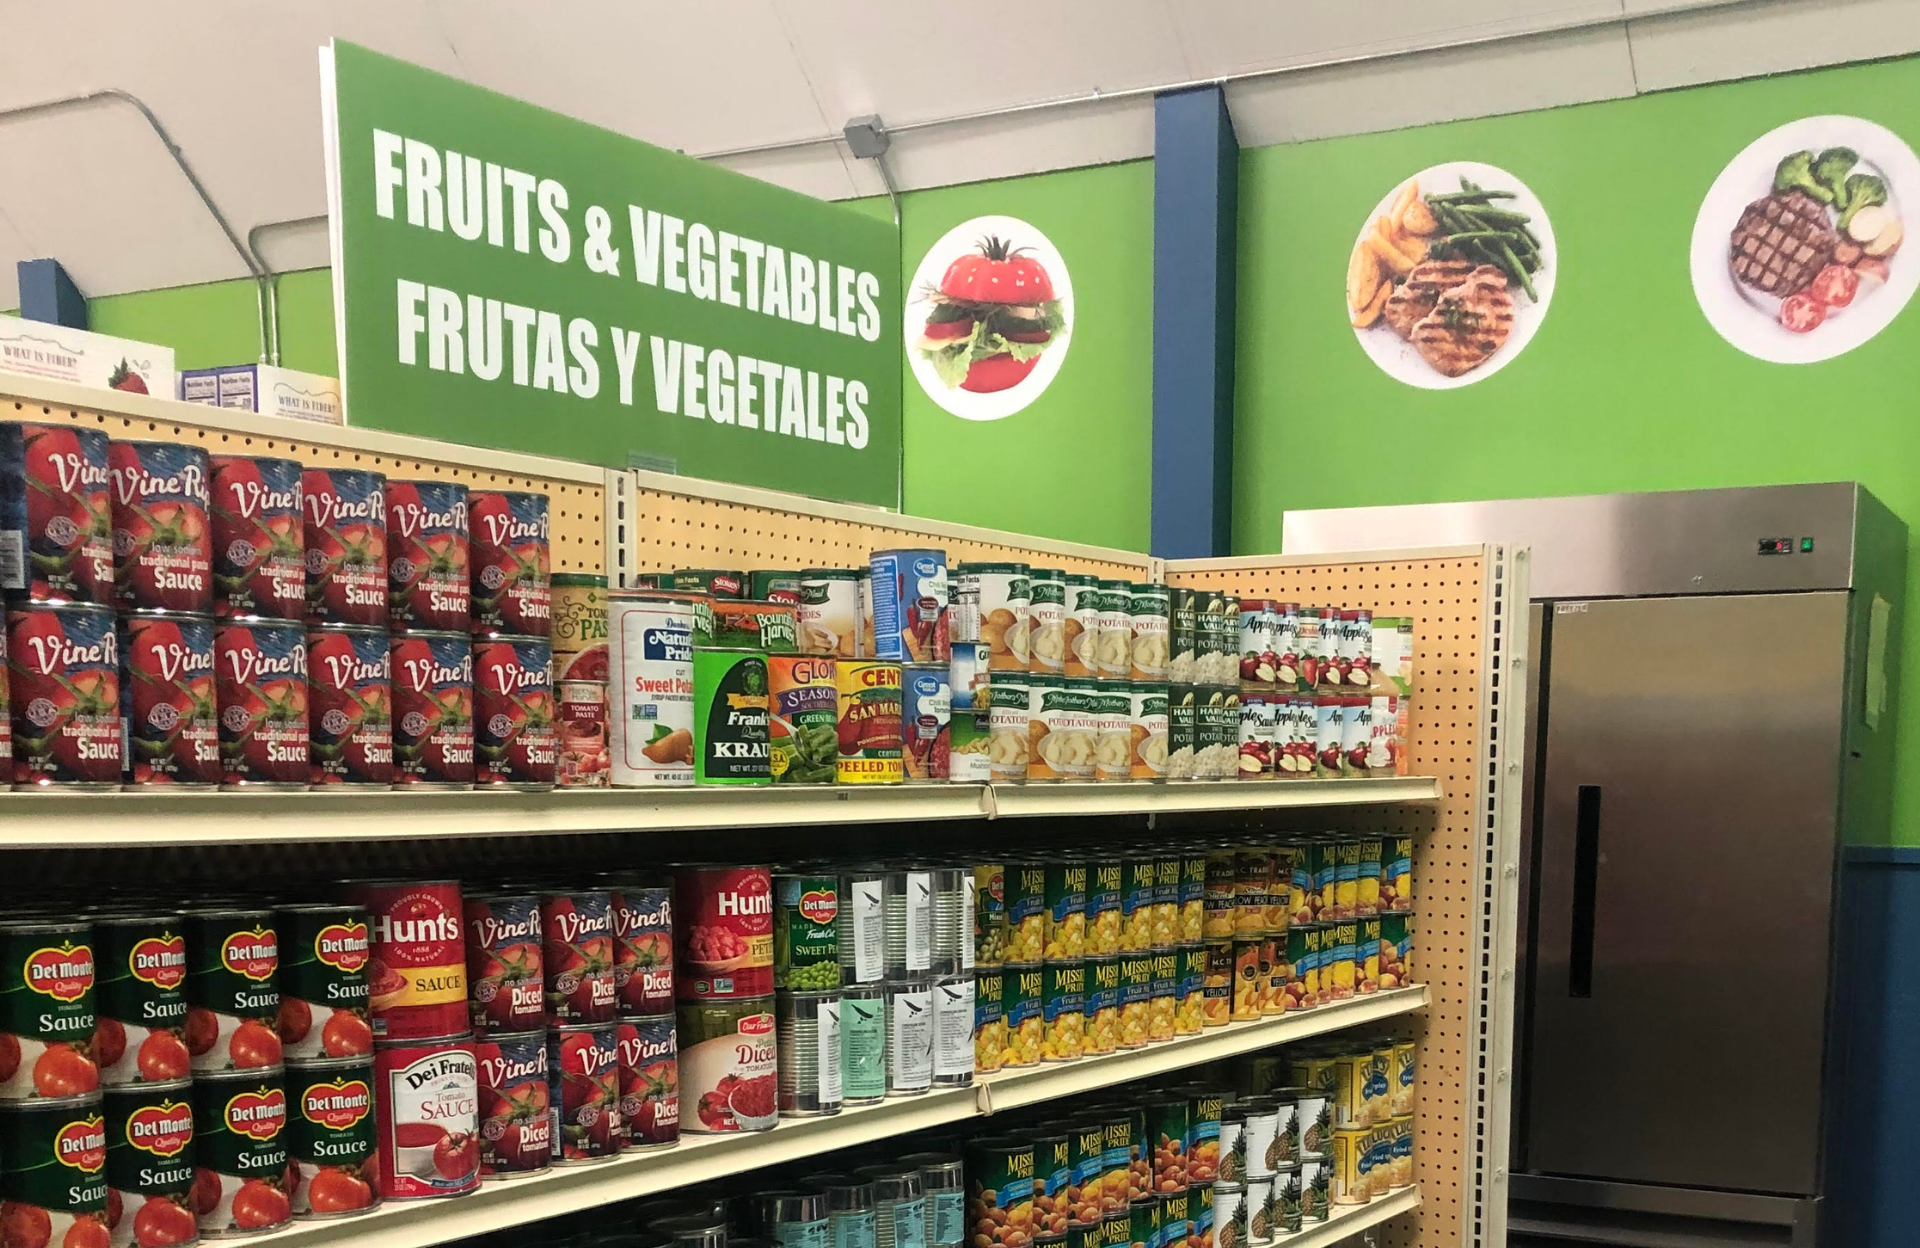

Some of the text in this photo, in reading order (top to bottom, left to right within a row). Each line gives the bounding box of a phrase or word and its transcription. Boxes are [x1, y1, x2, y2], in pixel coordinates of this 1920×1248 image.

[372, 128, 882, 343] FRUITS & VEGETABLES
[3, 344, 31, 360] WHAT
[397, 278, 869, 450] FRUTAS Y VEGETALES
[278, 394, 300, 409] WHAT
[302, 399, 310, 409] IS
[230, 481, 292, 519] Vine
[305, 491, 368, 529] Vine
[393, 501, 451, 538] Vine
[483, 512, 540, 547] Vine
[154, 569, 203, 591] Sauce
[345, 584, 384, 607] Sauce
[430, 591, 467, 613] Sauce
[28, 636, 100, 676] Vine
[151, 643, 210, 682] Vine
[225, 647, 291, 685] Vine
[324, 654, 383, 690] Vine
[404, 658, 462, 693] Vine
[491, 662, 545, 696] Vine
[635, 676, 675, 693] Sweet
[571, 704, 599, 713] TOMATO
[575, 711, 595, 719] PASTE
[849, 704, 876, 723] SAN
[799, 714, 825, 724] GREEN
[76, 737, 119, 760] Sauce
[267, 741, 307, 763] Sauce
[837, 761, 884, 773] PEELED
[390, 893, 444, 912] PROUDLY GROWN
[803, 900, 818, 911] Del
[555, 912, 603, 943] Vine
[612, 908, 659, 937] Vine
[471, 917, 529, 949] Vine
[228, 945, 251, 961] Del
[321, 938, 343, 953] Del
[414, 945, 446, 962] NATURAL
[795, 944, 827, 956] SWEET
[137, 953, 160, 969] Del
[248, 961, 271, 972] Quality
[340, 954, 362, 965] Quality
[32, 962, 93, 980] Del Monte
[55, 981, 82, 993] Quality
[327, 982, 370, 1000] Sauce
[415, 974, 460, 992] SAUCE
[643, 973, 671, 992] Diced
[234, 991, 279, 1010] Sauce
[511, 984, 542, 1006] Diced
[1205, 988, 1229, 997] YELLOW
[143, 1001, 187, 1019] Sauce
[39, 1013, 94, 1033] Sauce
[742, 1021, 756, 1032] Our
[619, 1039, 667, 1068] Vine
[735, 1044, 775, 1065] Diced
[405, 1063, 438, 1090] Dei
[481, 1057, 536, 1089] Vine
[307, 1094, 368, 1111] Del Monte
[435, 1091, 466, 1103] Tomato
[231, 1107, 255, 1123] Del
[326, 1112, 354, 1123] Quality
[420, 1098, 475, 1121] SAUCE
[654, 1101, 678, 1120] Diced
[133, 1120, 158, 1137] Del
[251, 1121, 276, 1133] Quality
[330, 1131, 354, 1139] TOMATO
[520, 1120, 549, 1143] Diced
[62, 1137, 84, 1154] Del
[154, 1136, 181, 1149] Quality
[313, 1139, 367, 1157] Sauce
[237, 1149, 286, 1170] Sauce
[139, 1166, 192, 1187] Sauce
